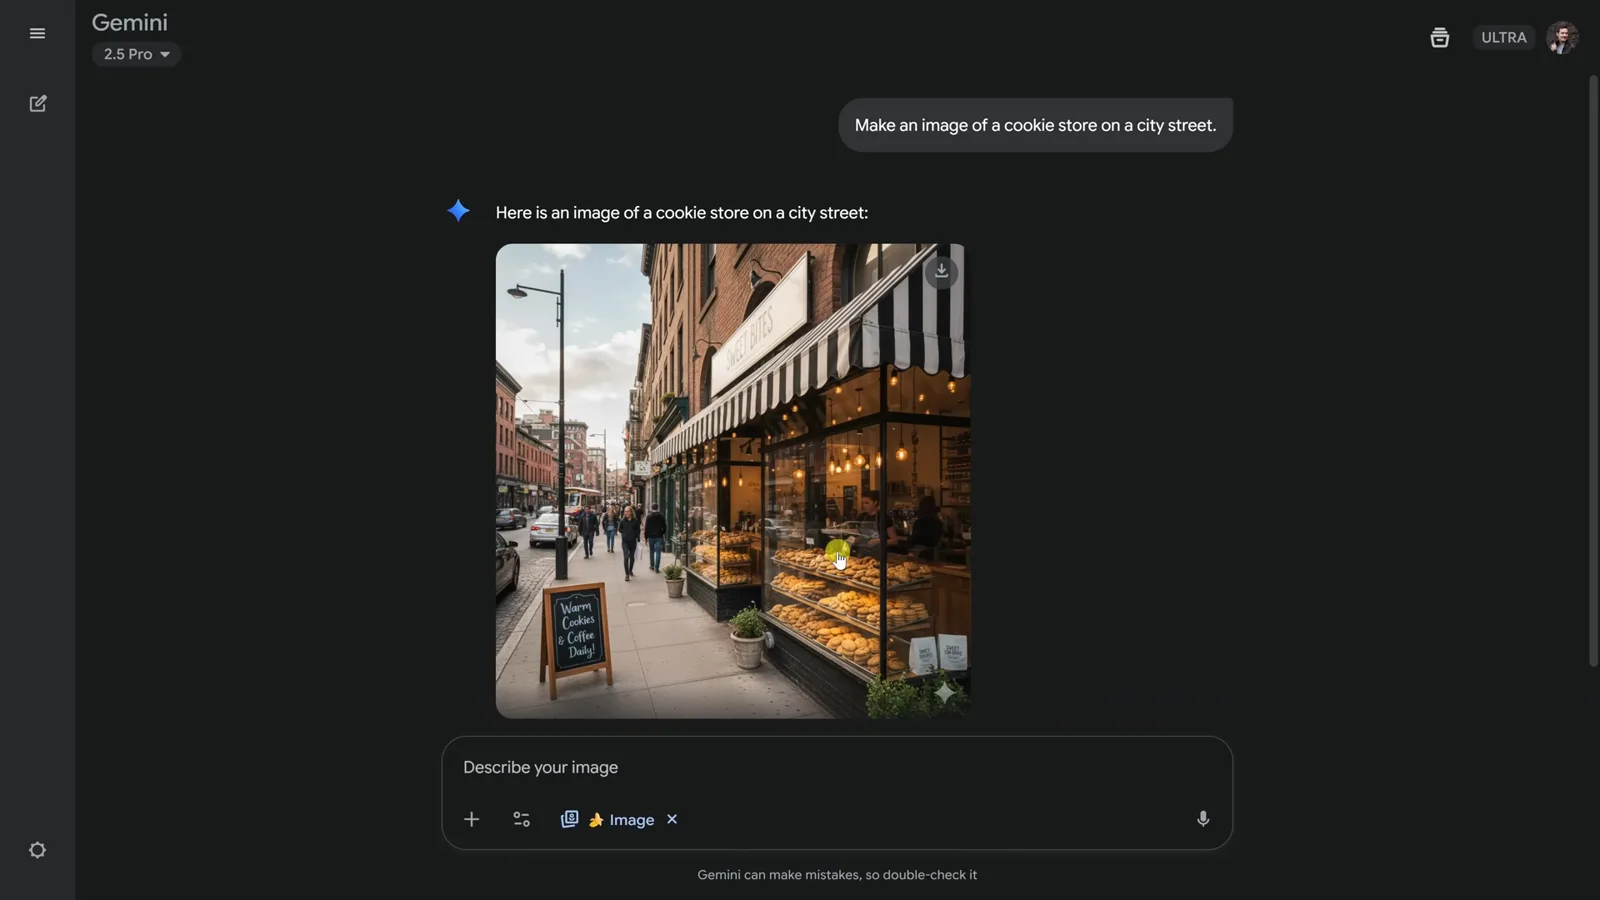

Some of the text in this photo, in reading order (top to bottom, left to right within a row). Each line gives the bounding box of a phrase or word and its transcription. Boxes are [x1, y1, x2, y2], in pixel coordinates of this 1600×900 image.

[92, 13, 168, 32] Gemini
[1481, 31, 1528, 44] ULTRA
[104, 48, 153, 60] 2.5 Pro
[855, 117, 1217, 136] Make an image of a cookie store on a city street.
[496, 205, 869, 224] Here is an image of a cookie store on a city street:
[727, 305, 773, 371] SWEET BITES
[560, 601, 592, 614] Warm
[562, 615, 595, 630] Cookies
[558, 630, 595, 646] & Coffee
[568, 643, 595, 659] Daily!
[463, 759, 619, 778] Describe your image
[610, 814, 655, 829] Image
[697, 868, 978, 882] Gemini can make mistakes, so double-check it
